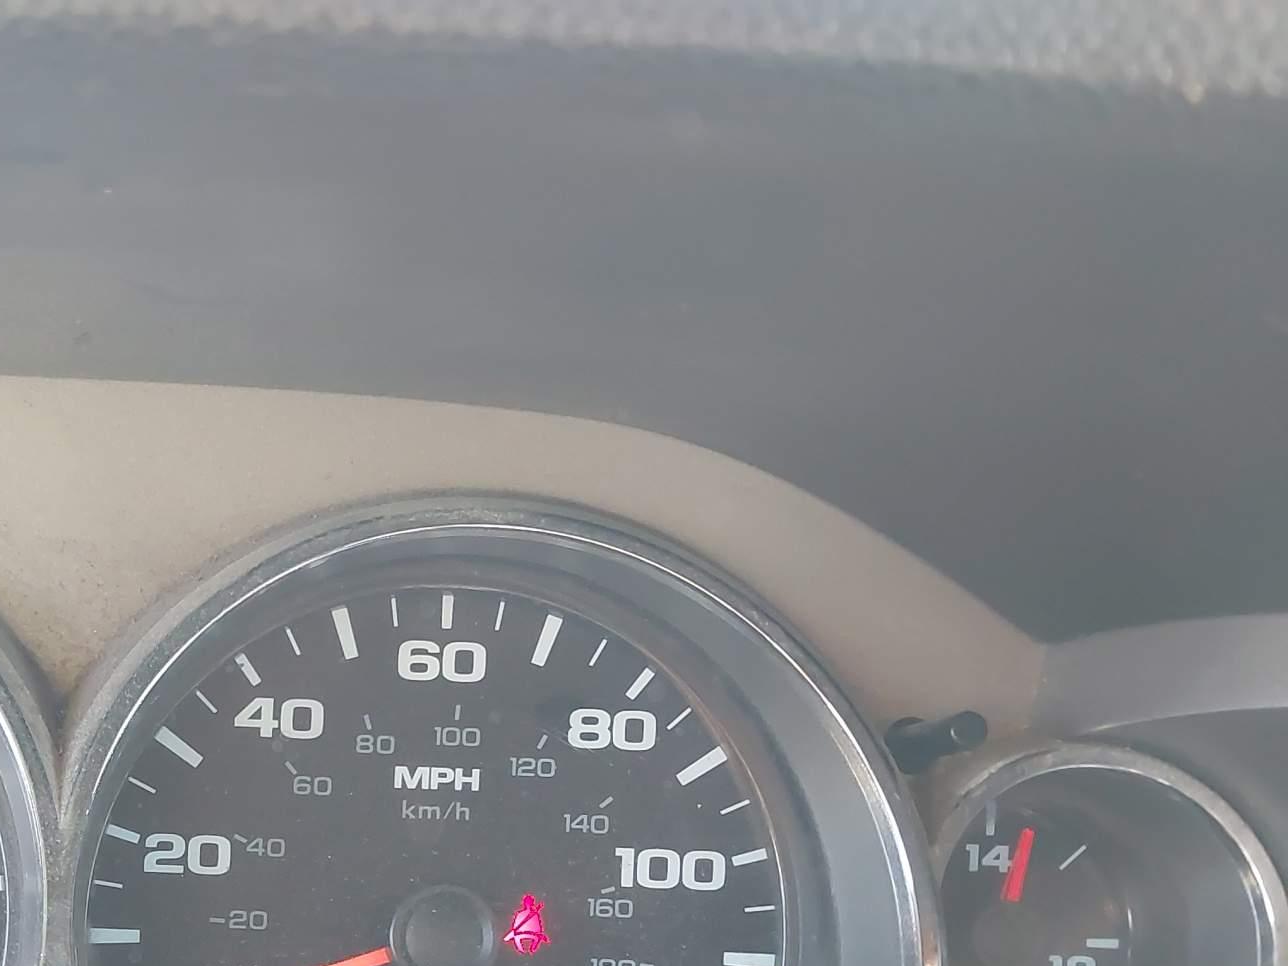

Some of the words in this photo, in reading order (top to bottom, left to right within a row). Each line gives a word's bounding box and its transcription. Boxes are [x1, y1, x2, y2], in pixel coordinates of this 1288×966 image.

[397, 640, 486, 682] 60
[234, 697, 324, 739] 40
[434, 726, 481, 747] 100
[567, 708, 657, 751] 80
[356, 735, 395, 754] 80
[510, 757, 556, 778] 120
[293, 776, 332, 796] 60
[393, 766, 480, 791] MPH
[401, 800, 470, 821] km/h
[563, 814, 610, 834] 140
[143, 833, 232, 876] 20
[246, 838, 286, 858] 40
[965, 844, 1012, 873] 14
[615, 847, 726, 891] 100
[587, 898, 634, 918] 160
[228, 910, 268, 930] 20
